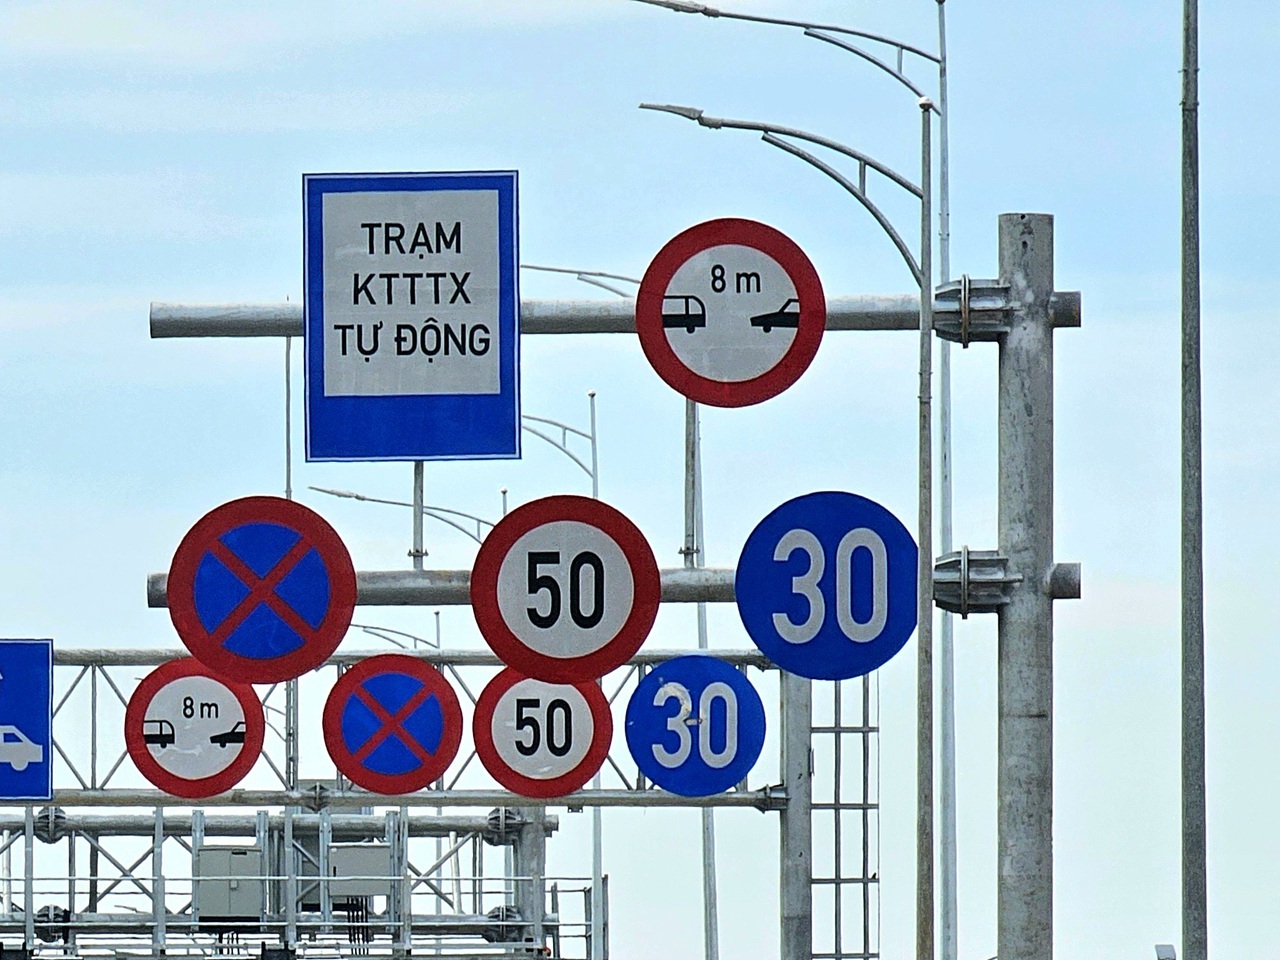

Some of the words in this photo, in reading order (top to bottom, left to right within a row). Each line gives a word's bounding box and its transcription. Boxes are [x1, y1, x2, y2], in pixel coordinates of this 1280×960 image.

[361, 222, 462, 259] TRẠM
[353, 272, 472, 305] KTTTX
[710, 264, 725, 293] 8
[736, 272, 761, 293] m
[334, 321, 383, 364] TỰ
[395, 318, 491, 362] ĐỘNG
[526, 551, 606, 629] 50
[772, 528, 888, 644] 30
[182, 697, 197, 719] 8
[200, 702, 219, 719] m
[514, 698, 573, 756] 50
[651, 685, 739, 769] 30
